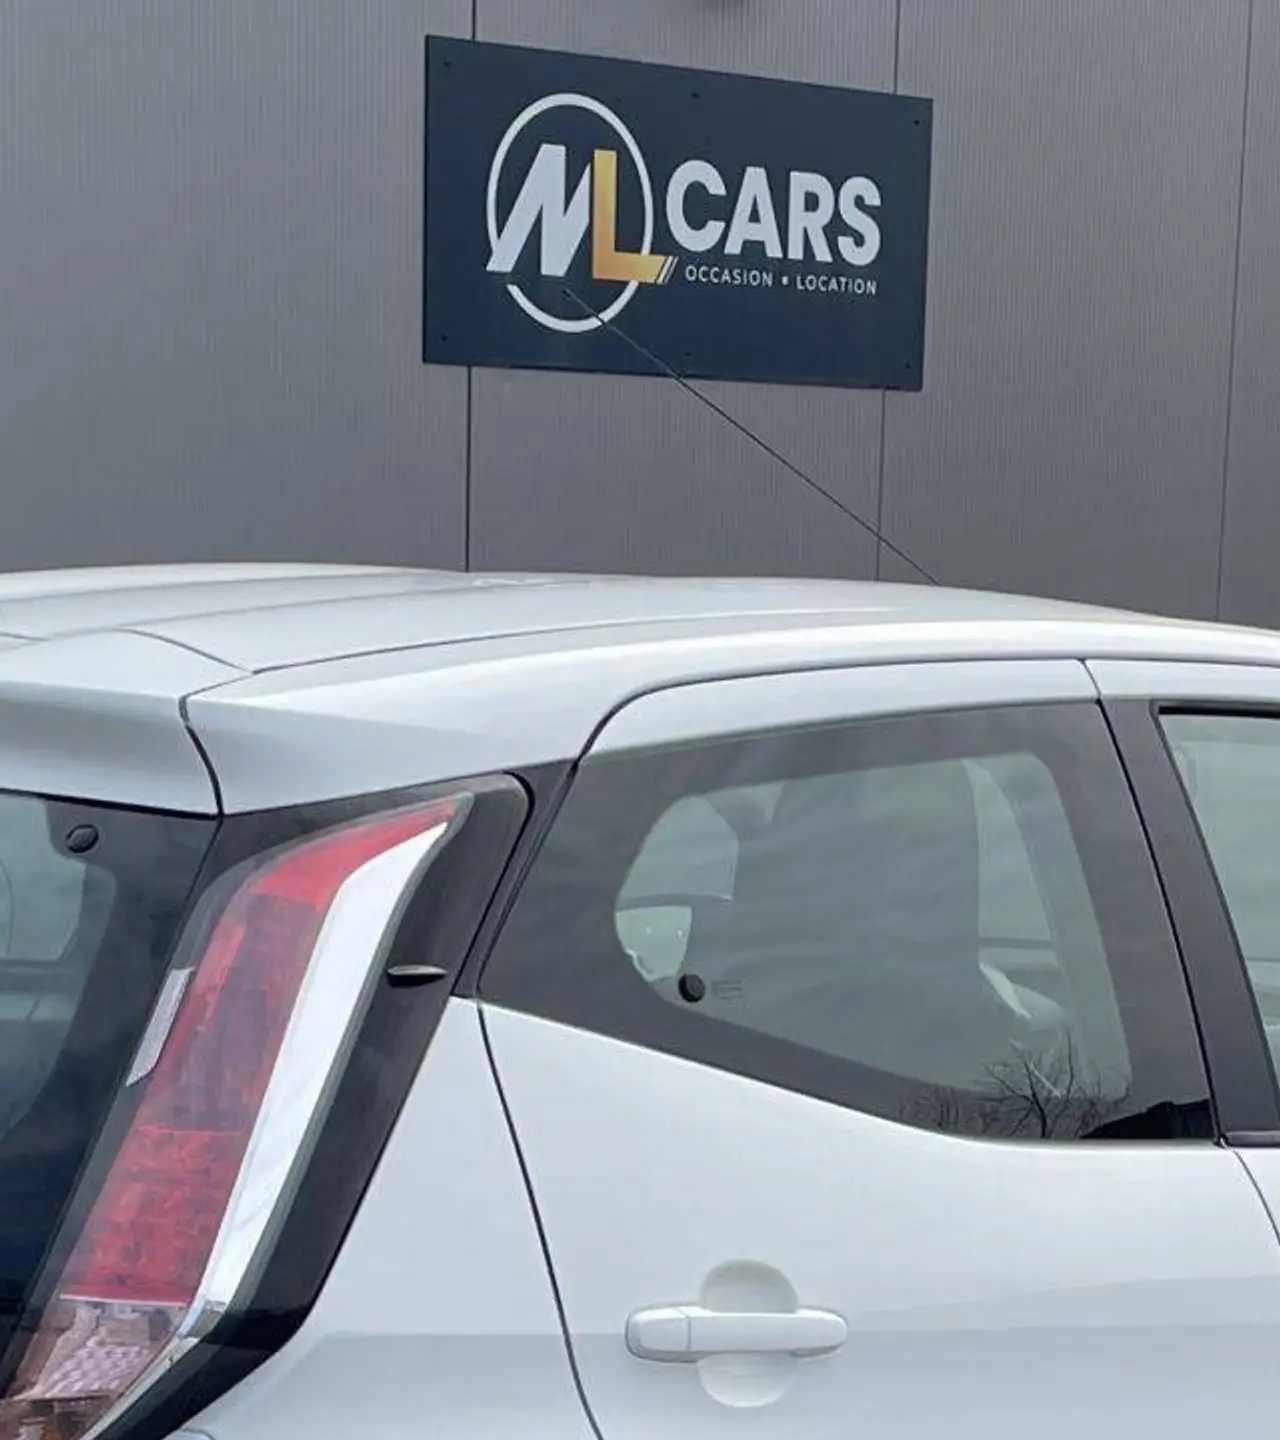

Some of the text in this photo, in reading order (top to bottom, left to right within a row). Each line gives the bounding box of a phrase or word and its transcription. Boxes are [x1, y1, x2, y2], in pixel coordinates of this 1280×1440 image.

[666, 160, 882, 266] CARS
[684, 264, 877, 296] OCCASION LOCATION
